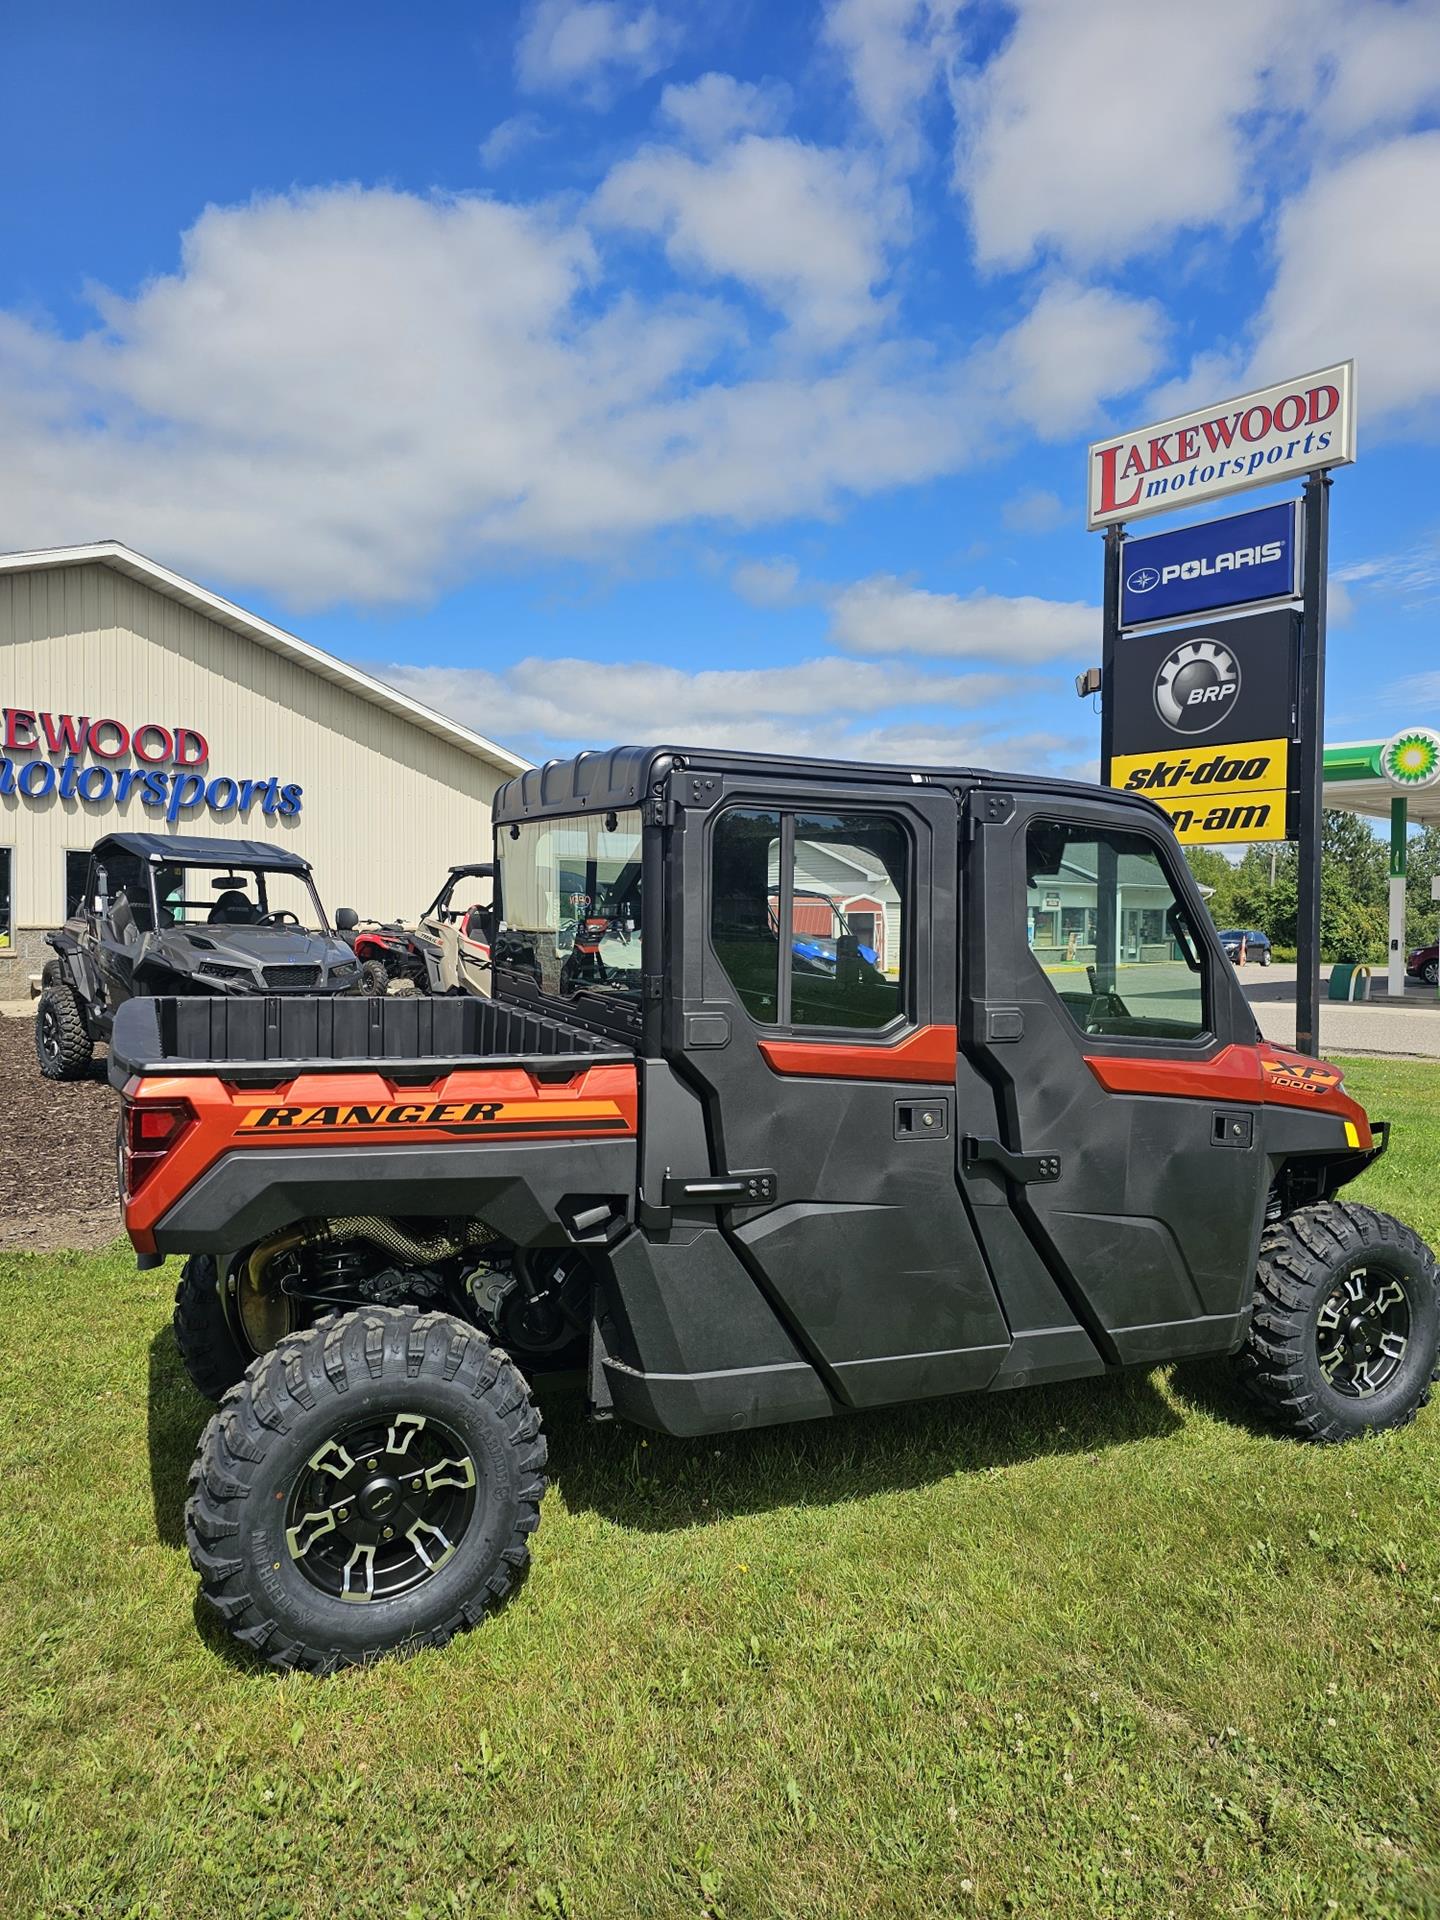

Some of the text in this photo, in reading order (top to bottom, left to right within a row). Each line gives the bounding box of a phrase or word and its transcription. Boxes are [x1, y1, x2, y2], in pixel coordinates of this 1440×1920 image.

[1094, 384, 1340, 516] LAKEWOOD
[1145, 430, 1332, 499] motorsports
[1162, 541, 1281, 585] POLARIS
[1186, 683, 1237, 705] BRP
[0, 707, 209, 766] EWOOD
[1124, 755, 1271, 791] ski-doo
[1171, 803, 1271, 832] n-am
[1270, 1060, 1332, 1079] XP
[1271, 1076, 1318, 1093] 1000
[254, 1102, 504, 1127] RANGER
[251, 1529, 315, 1625] X-TERRAIN
